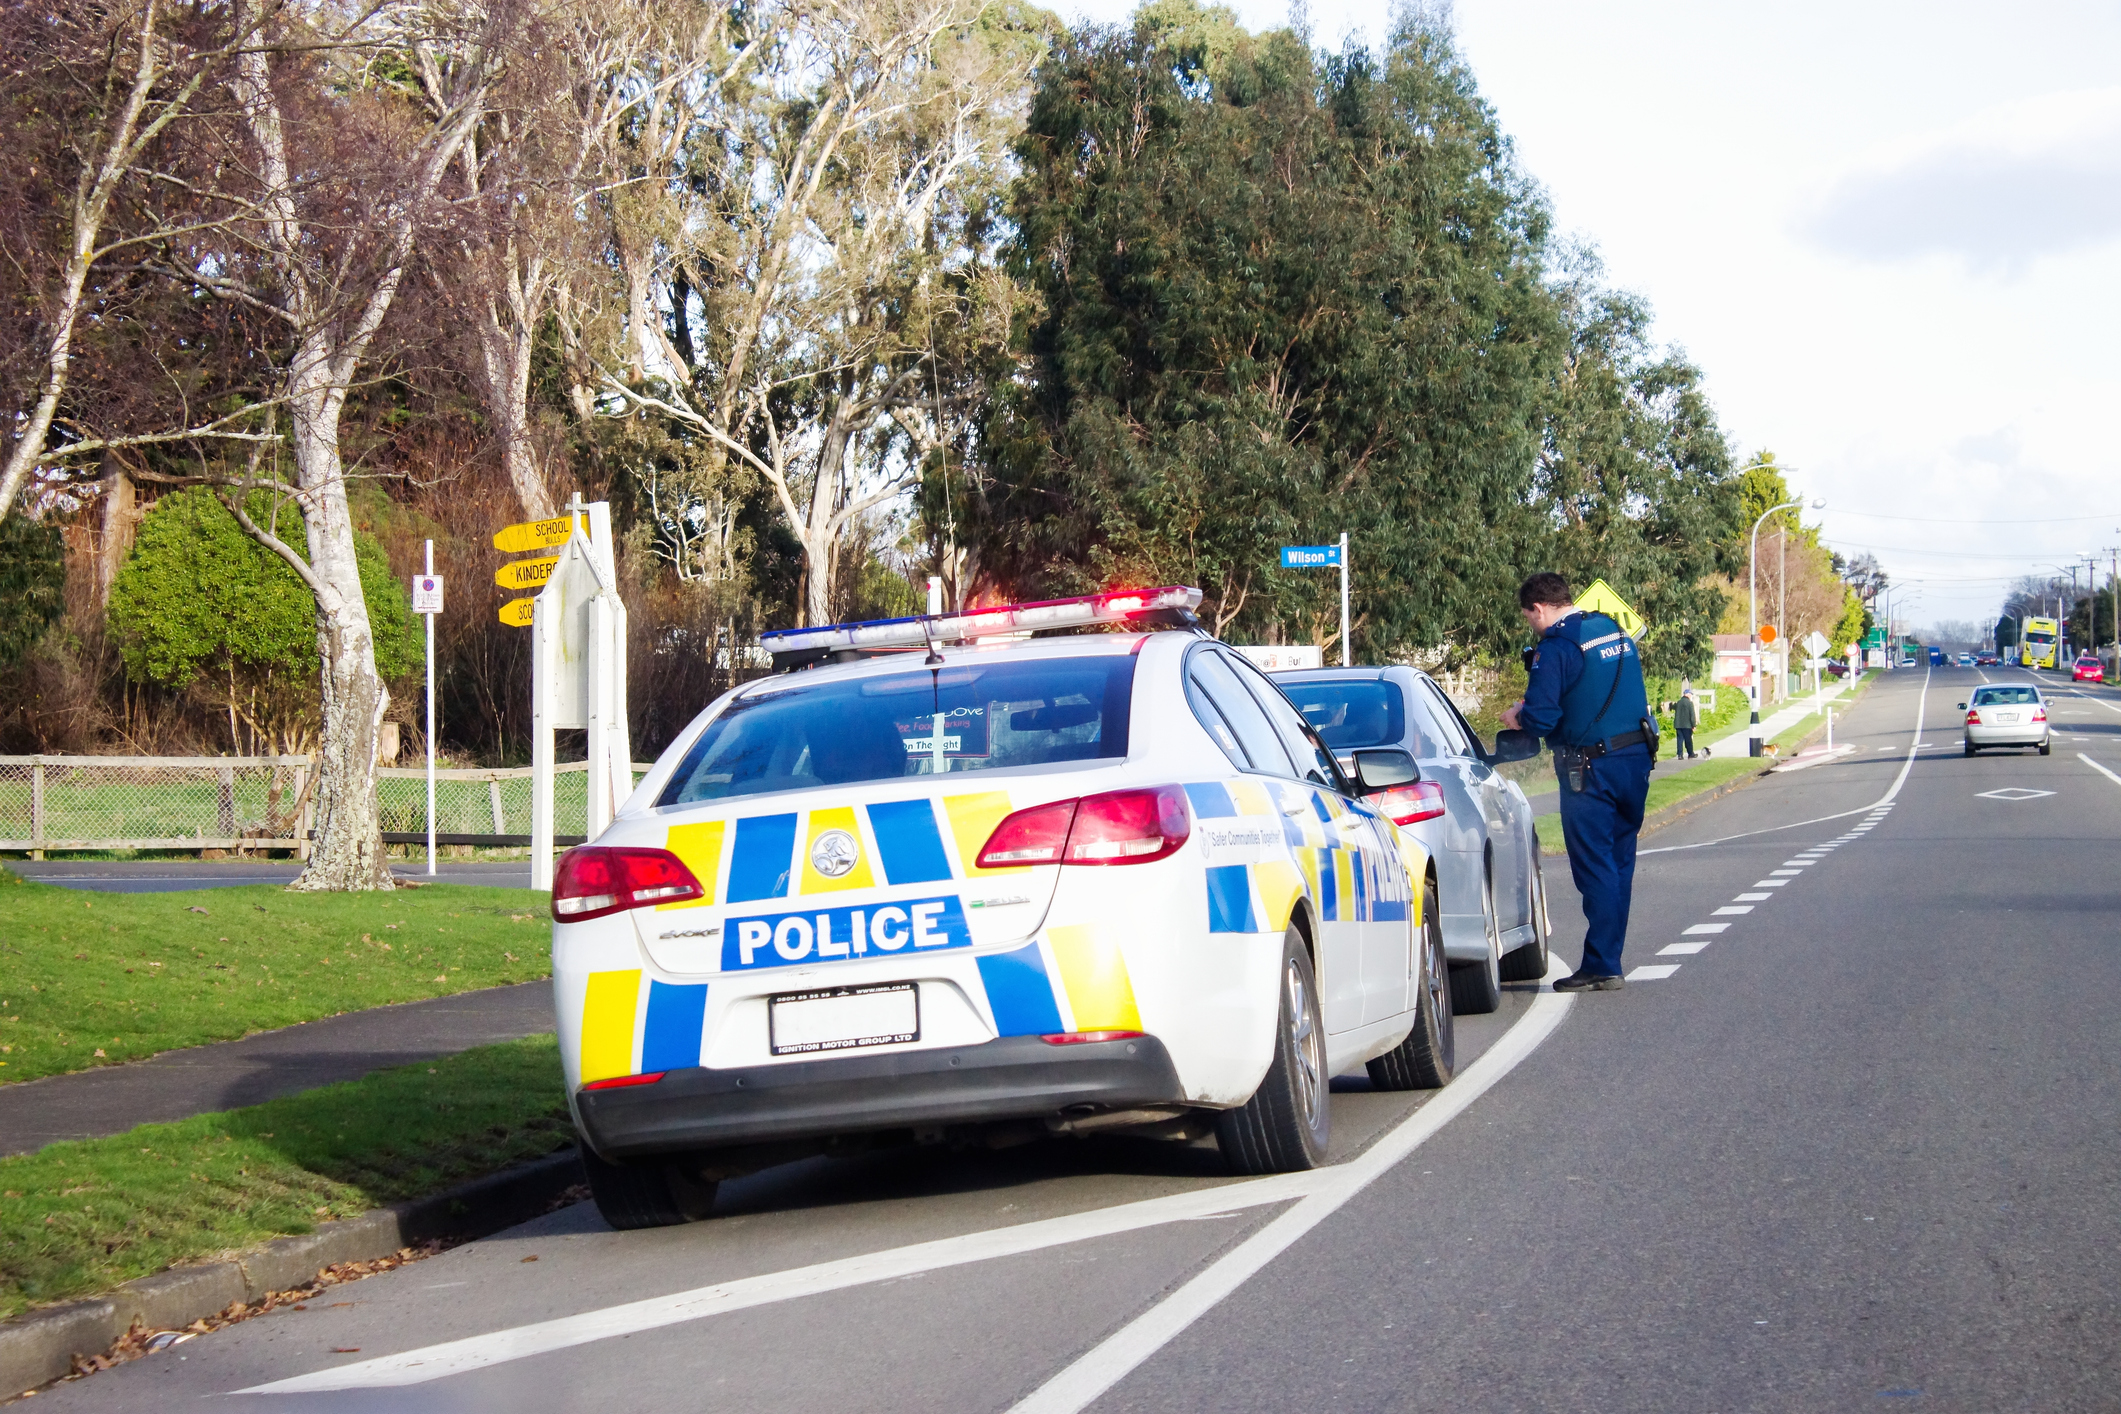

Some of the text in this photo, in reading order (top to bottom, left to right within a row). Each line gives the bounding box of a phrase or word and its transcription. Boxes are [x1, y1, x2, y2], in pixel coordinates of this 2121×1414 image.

[535, 520, 569, 537] SCHOOL
[1287, 551, 1325, 563] Wilson
[916, 741, 932, 750] The
[943, 740, 959, 750] ght
[738, 901, 949, 965] POLICE
[778, 1034, 913, 1054] IGNITION MOTOR GROUP LTD
